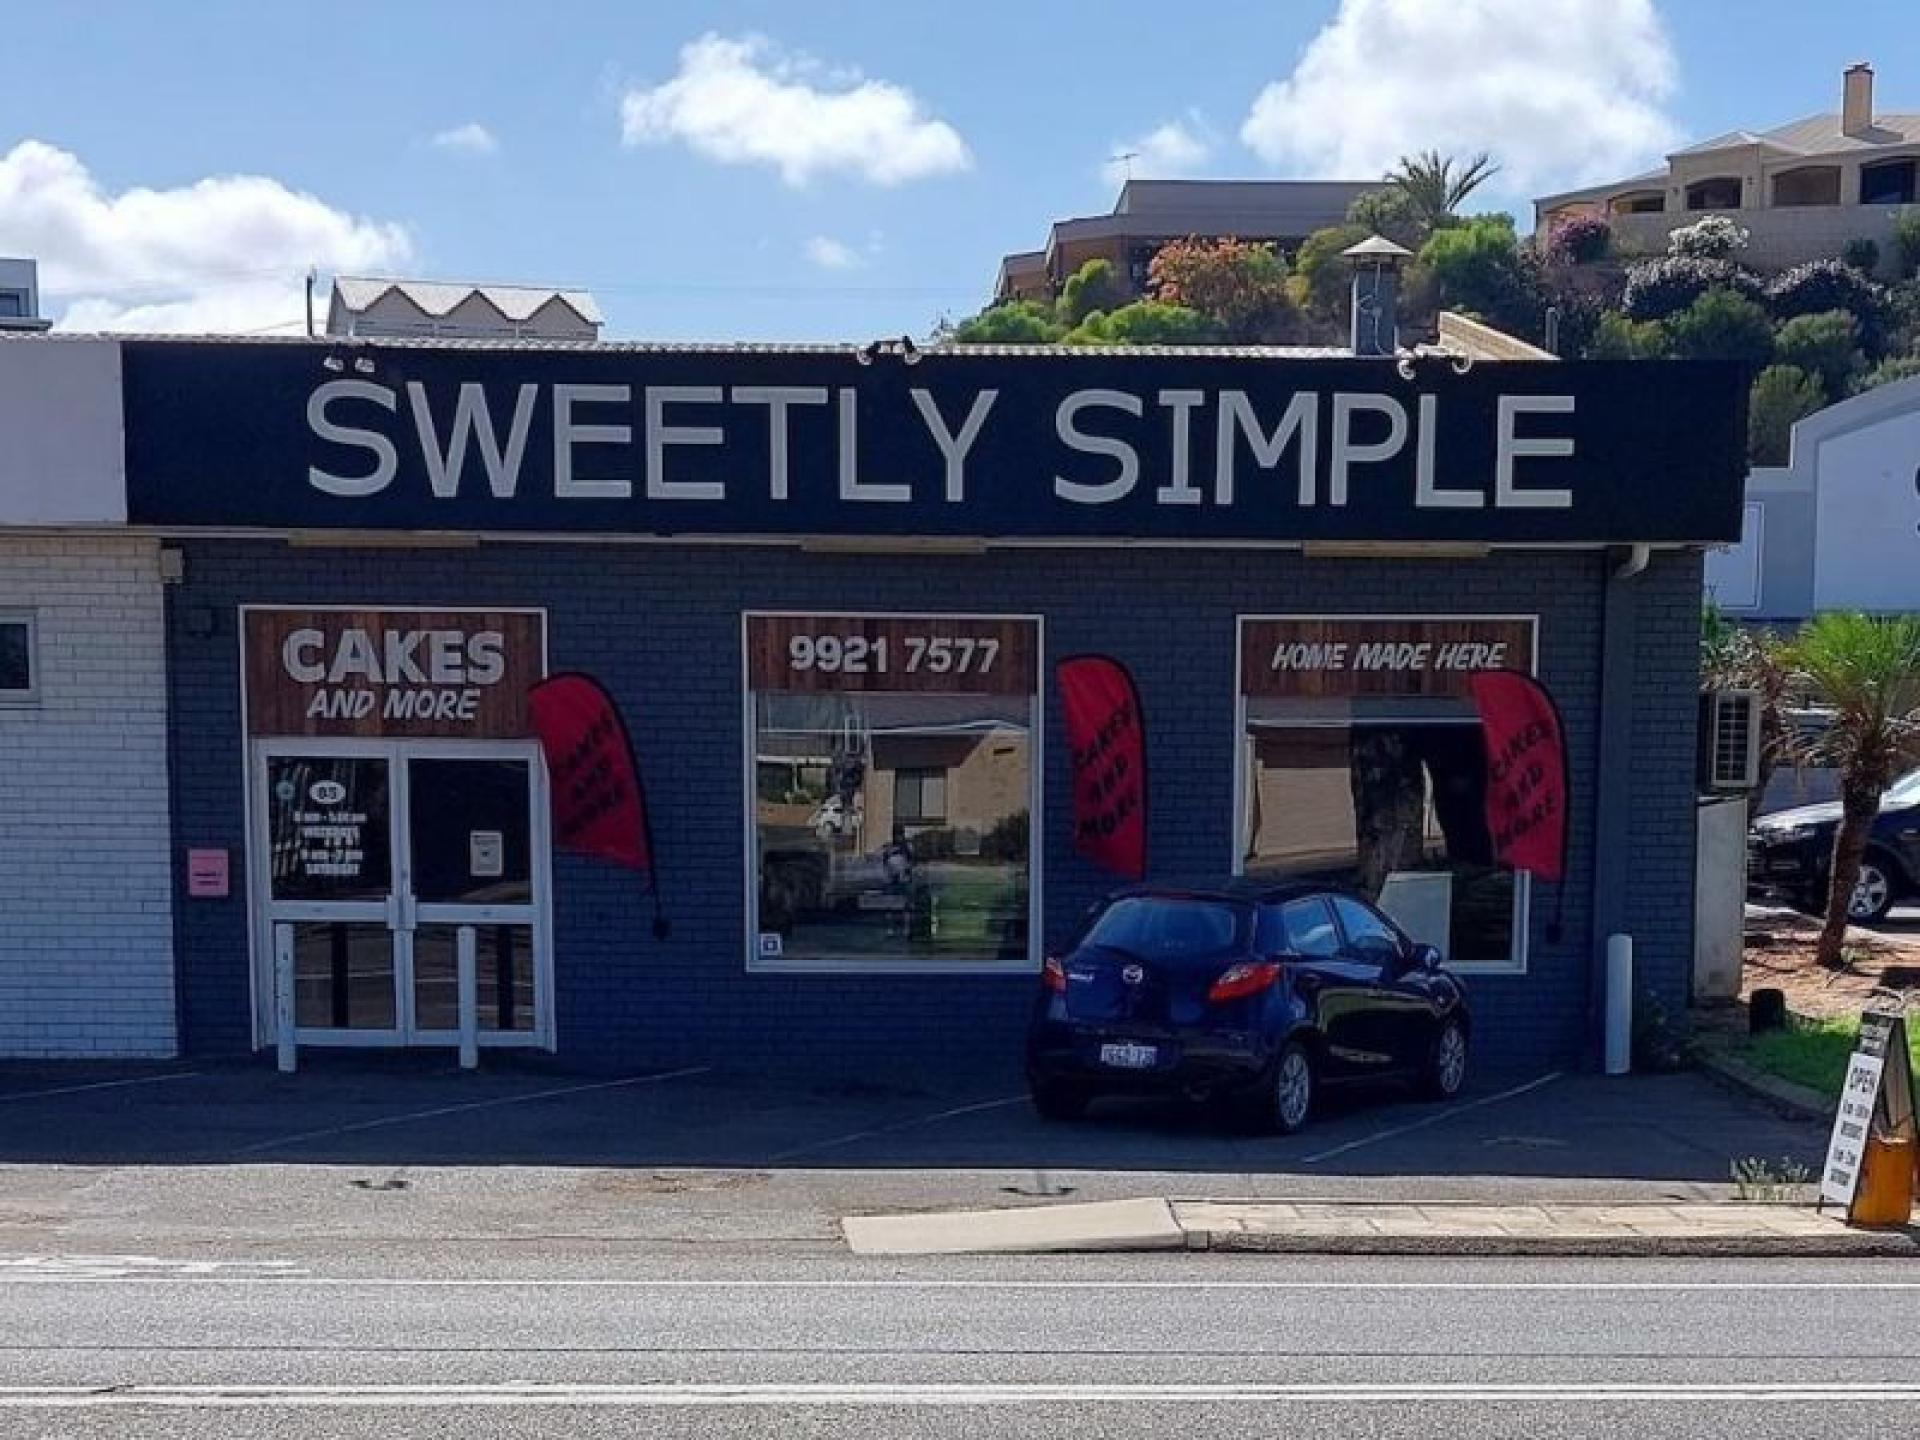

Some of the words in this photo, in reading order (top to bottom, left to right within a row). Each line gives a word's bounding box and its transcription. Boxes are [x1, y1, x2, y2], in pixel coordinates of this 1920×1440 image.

[306, 379, 998, 503] SWEETLY
[1055, 388, 1576, 508] SIMPLE
[282, 628, 505, 685] CAKES
[789, 635, 887, 673] 9921
[904, 636, 999, 673] 7577
[1271, 642, 1348, 671] HOME
[1352, 642, 1432, 671] MADE
[1434, 642, 1508, 670] HERE
[306, 688, 375, 719] AND
[383, 688, 481, 721] MORE
